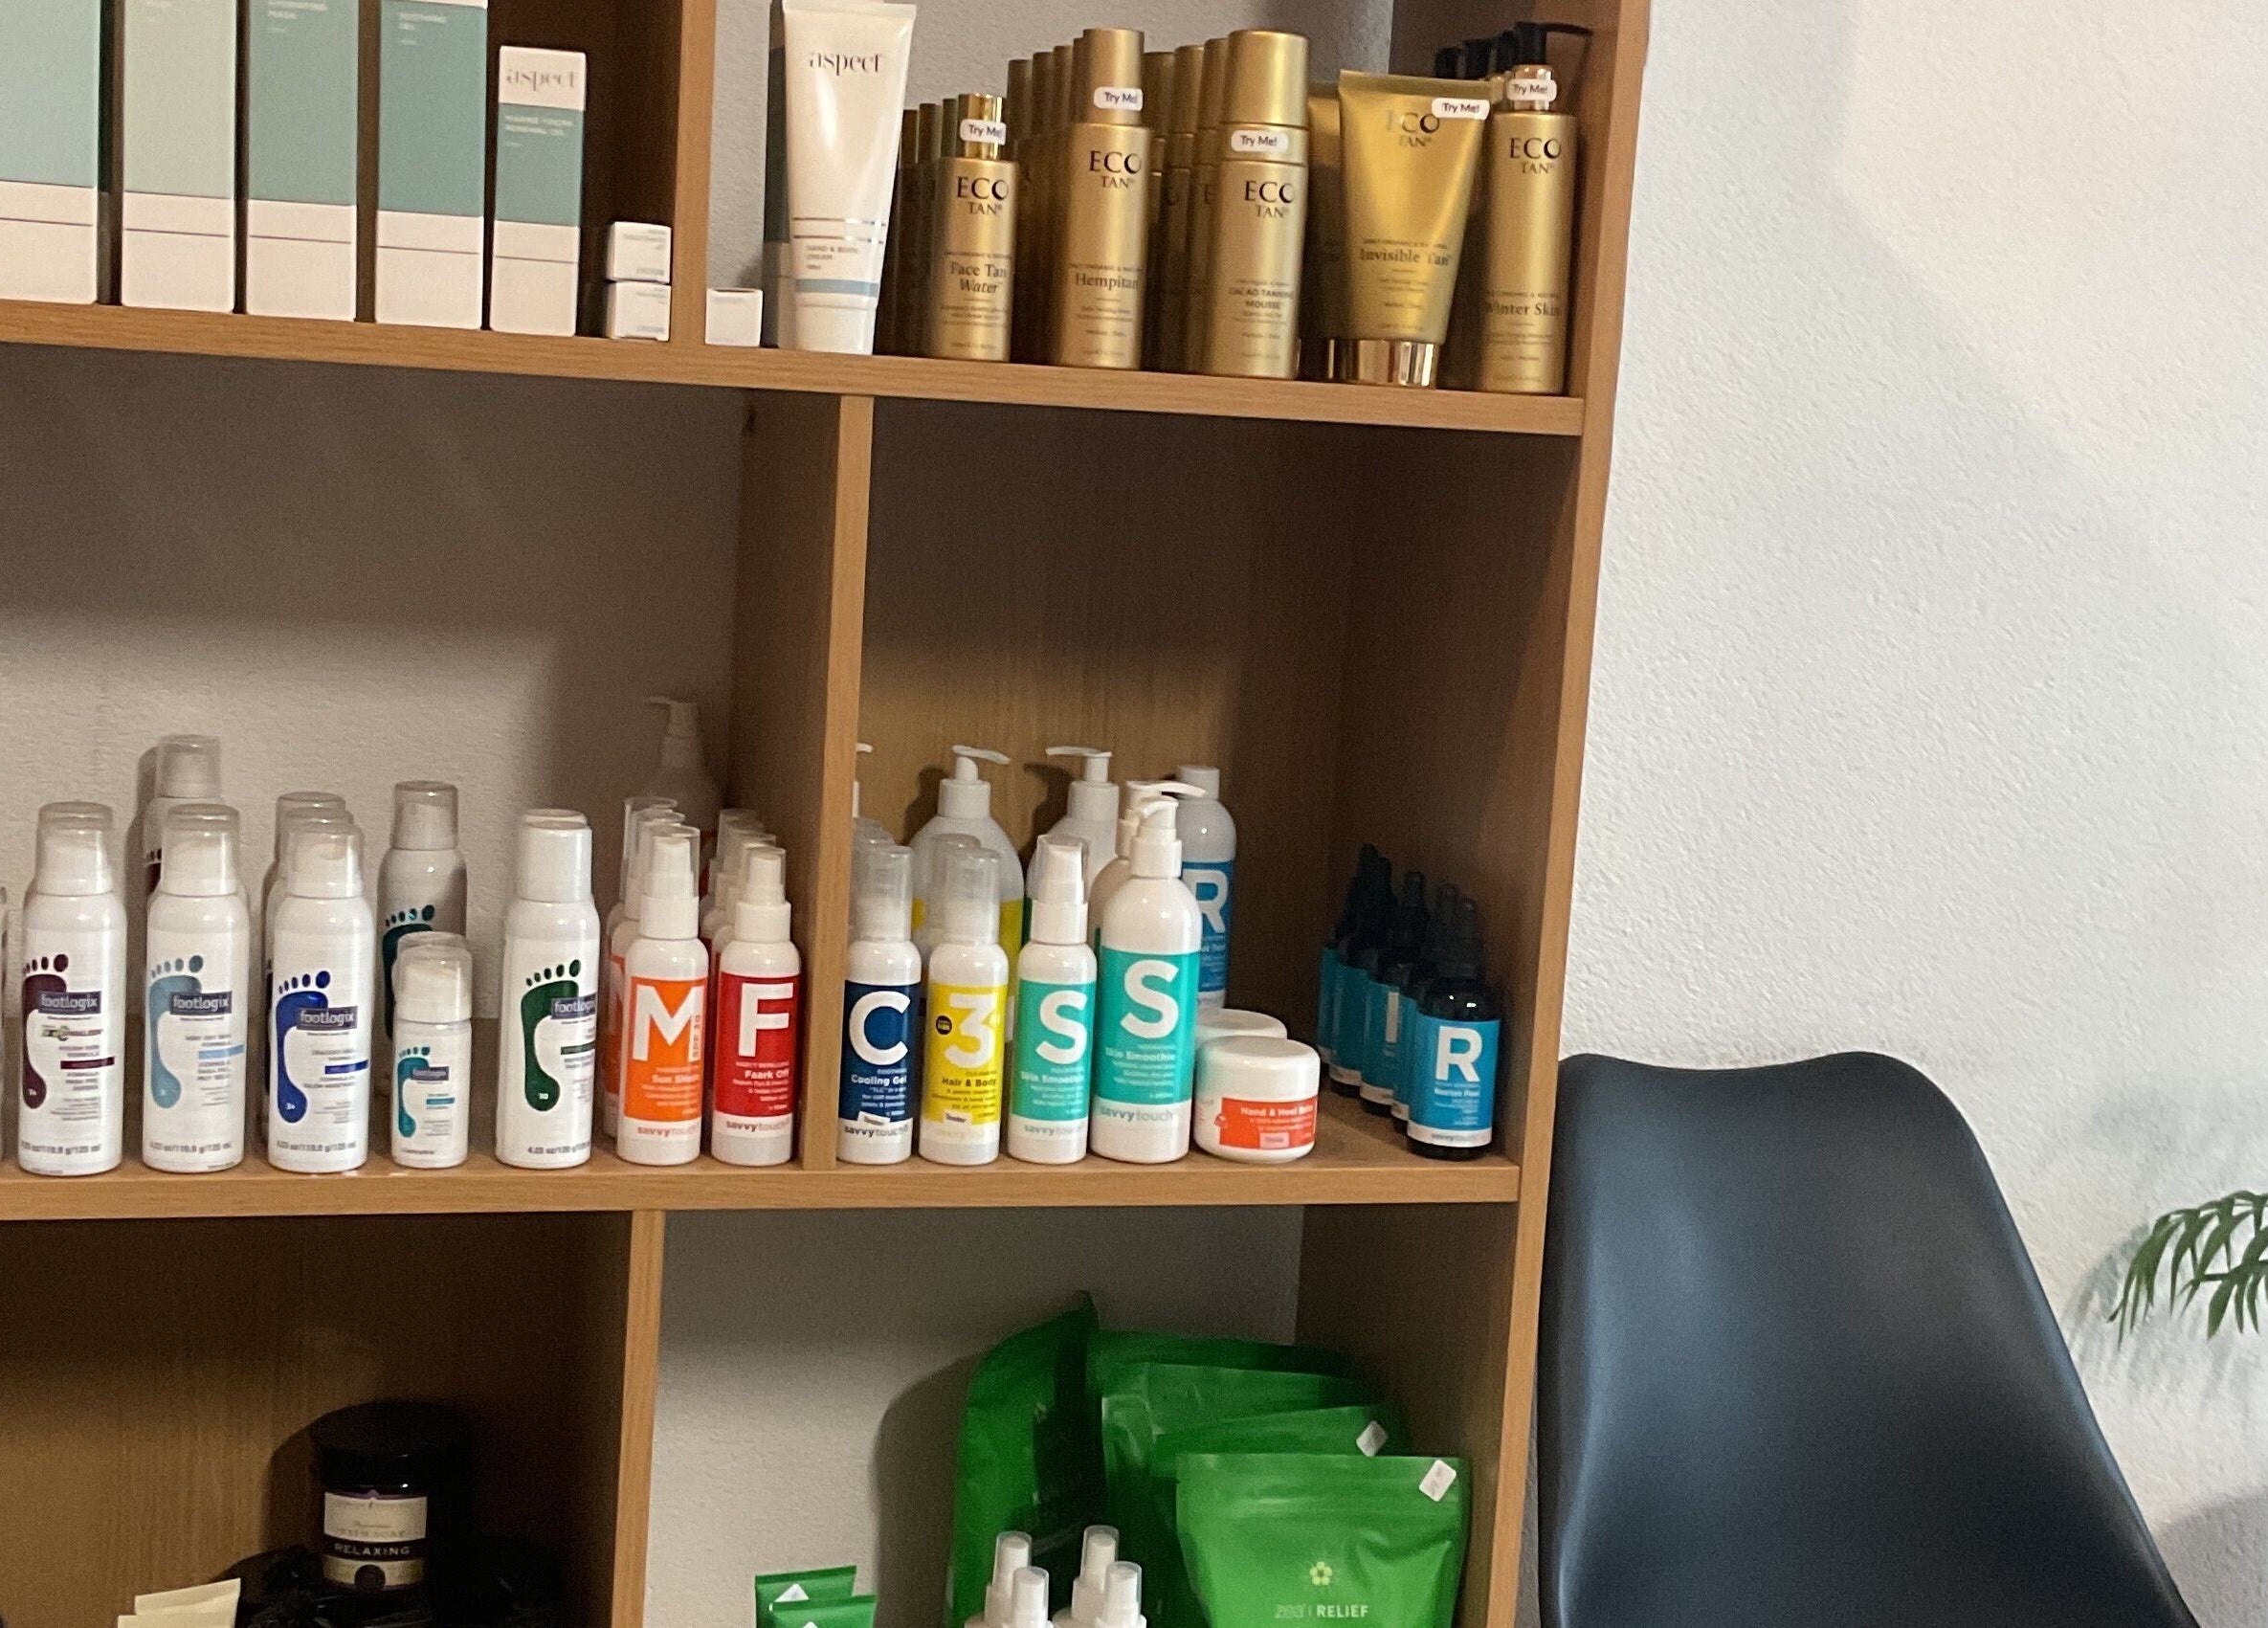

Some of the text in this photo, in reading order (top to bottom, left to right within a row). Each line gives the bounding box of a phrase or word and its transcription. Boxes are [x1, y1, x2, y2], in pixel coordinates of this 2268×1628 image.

[809, 52, 880, 77] aspect
[1442, 101, 1458, 114] Try
[967, 123, 985, 138] Try
[1240, 135, 1278, 147] Try Me!
[1509, 137, 1562, 160] ECO
[1089, 149, 1143, 174] ECO
[957, 176, 1010, 201] ECO
[1244, 180, 1296, 204] ECO
[1360, 248, 1420, 264] Invisible
[949, 261, 981, 277] Face
[959, 278, 998, 294] Water
[1075, 272, 1140, 292] Hempitan
[1183, 869, 1229, 933] R
[41, 992, 98, 1012] footlogix
[173, 993, 230, 1013] footlogix
[1120, 959, 1179, 1039] S
[300, 1008, 354, 1028] footlogix
[633, 984, 705, 1063] M
[738, 983, 794, 1058] F
[1034, 990, 1088, 1065] S
[849, 991, 911, 1066] C
[945, 992, 997, 1069] 3
[1435, 1026, 1482, 1082] R
[850, 1073, 908, 1087] Cooling Gel
[942, 1076, 963, 1087] Hair
[334, 1542, 411, 1556] RELAXING
[1316, 1603, 1369, 1618] RELIEF
